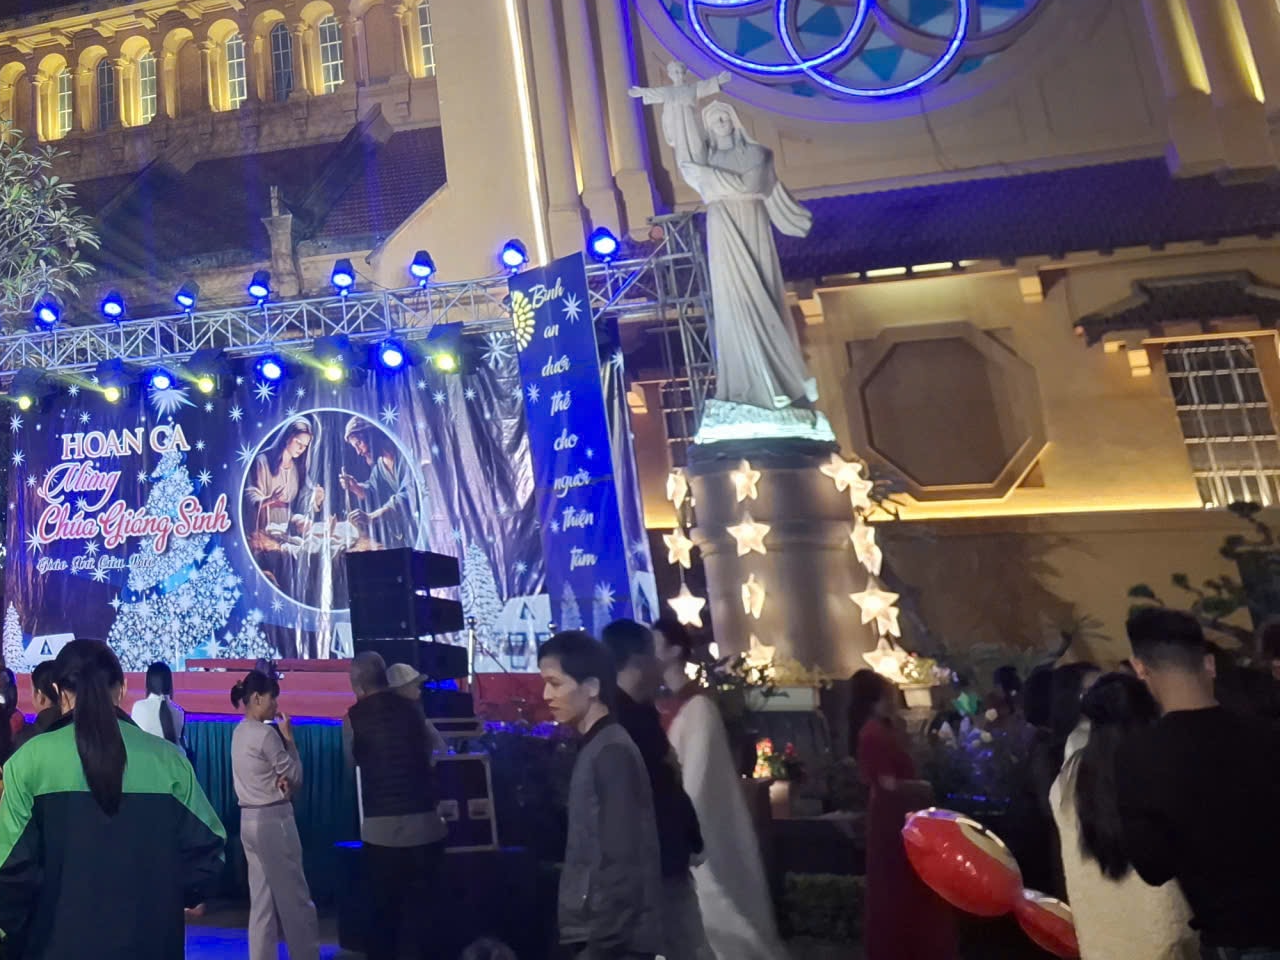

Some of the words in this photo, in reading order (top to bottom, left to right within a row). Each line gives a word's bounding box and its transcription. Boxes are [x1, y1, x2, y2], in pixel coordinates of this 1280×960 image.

[543, 324, 559, 338] an
[61, 427, 145, 461] HOAN
[149, 424, 191, 453] CA
[553, 427, 579, 451] cho
[37, 460, 122, 513] Mừng
[553, 467, 591, 498] người
[37, 502, 100, 545] Chúa
[97, 499, 174, 554] Giáng
[173, 493, 232, 537] Sinh
